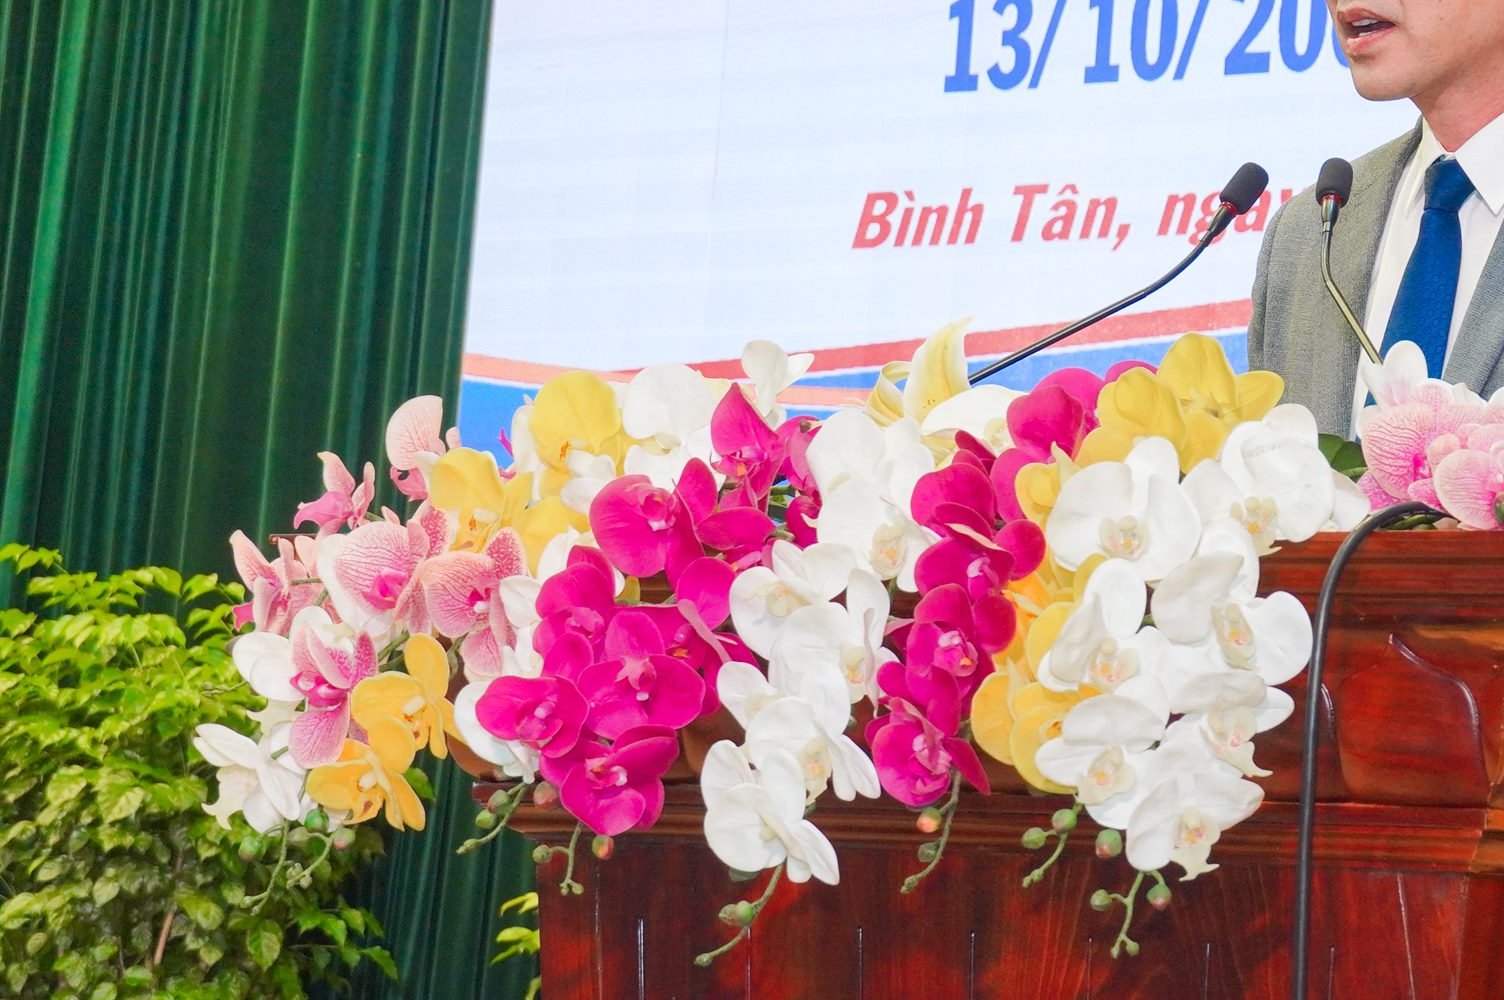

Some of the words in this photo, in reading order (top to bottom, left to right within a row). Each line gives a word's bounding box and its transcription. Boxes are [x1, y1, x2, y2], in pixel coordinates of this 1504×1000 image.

[852, 188, 984, 249] Bình
[1011, 184, 1130, 250] Tân,
[1157, 187, 1292, 246] ng
